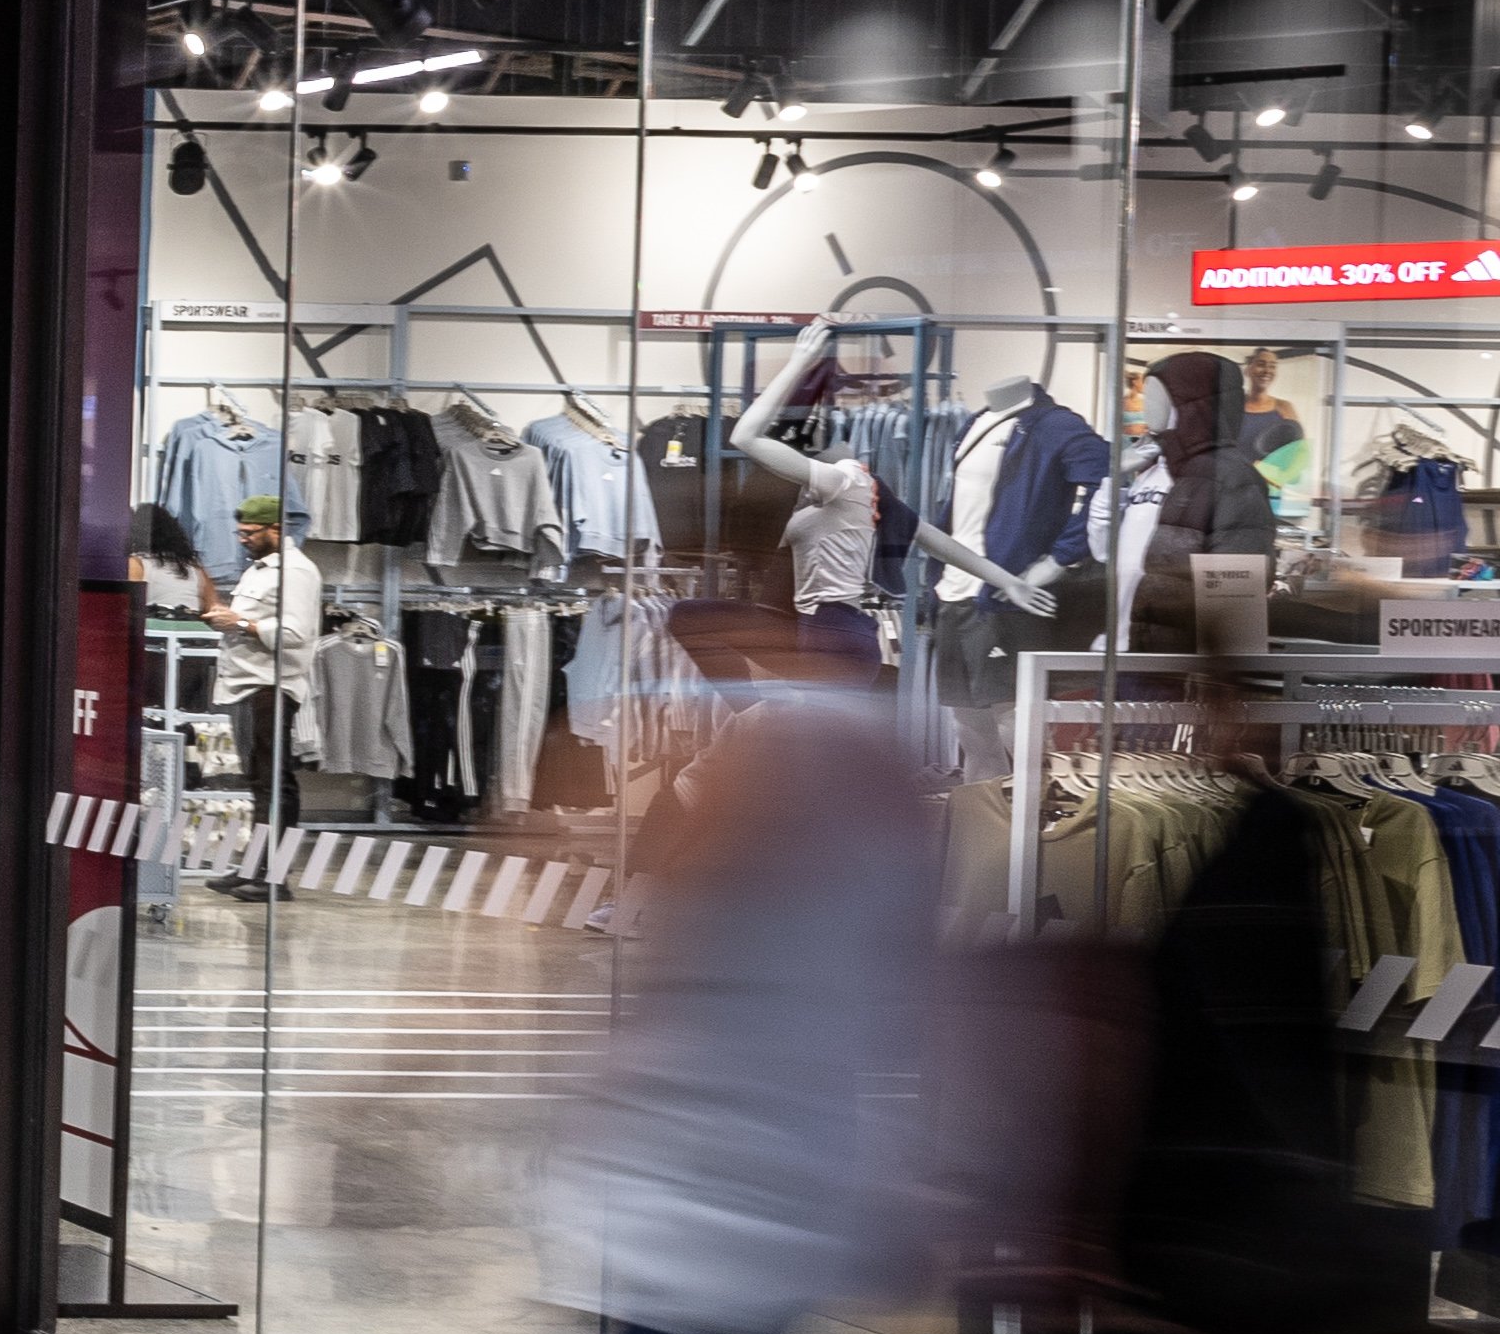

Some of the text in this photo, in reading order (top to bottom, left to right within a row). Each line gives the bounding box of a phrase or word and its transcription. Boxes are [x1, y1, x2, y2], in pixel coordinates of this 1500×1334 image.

[1200, 261, 1448, 289] ADDITIONAL 30% OFF
[173, 305, 248, 317] SPORTSWEAR
[652, 313, 682, 327] TAKE
[1388, 618, 1500, 637] SPORTSWEAR
